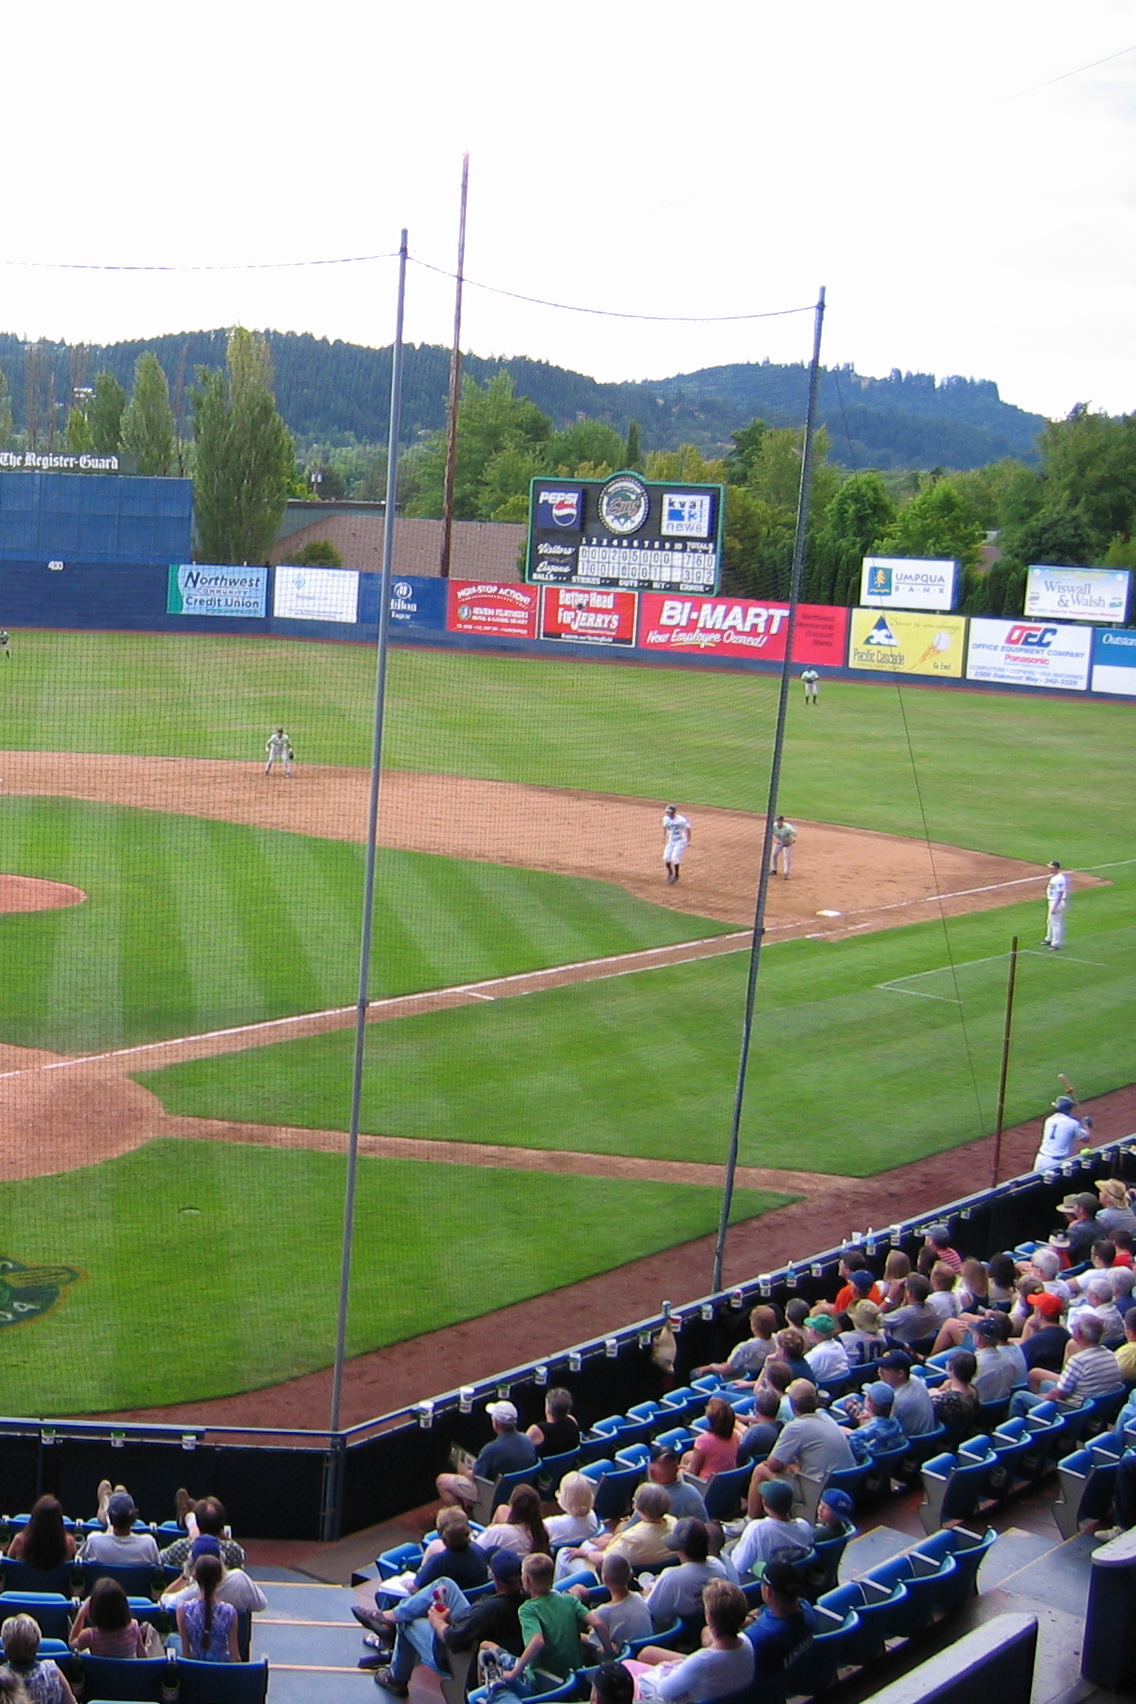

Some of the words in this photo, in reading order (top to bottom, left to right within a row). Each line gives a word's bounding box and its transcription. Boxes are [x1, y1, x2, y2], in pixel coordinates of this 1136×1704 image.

[0, 452, 22, 468] The
[24, 452, 118, 470] Register-Guard
[539, 491, 579, 504] PEPSI
[47, 560, 64, 571] 400
[184, 570, 261, 588] Northwest
[895, 573, 946, 584] UMPQUA
[198, 588, 249, 596] COMMUNITY
[1044, 581, 1092, 595] Wiswall
[186, 596, 222, 607] Credit
[225, 597, 259, 608] Union
[559, 589, 589, 608] Better
[1057, 594, 1069, 608] &
[1070, 593, 1106, 608] Walsh
[557, 607, 575, 625] For
[570, 609, 619, 630] JERRY'S
[659, 600, 791, 635] BI-MART
[670, 628, 721, 649] Employee
[722, 629, 769, 649] Owned!
[854, 648, 876, 662] Pacific
[876, 650, 905, 665] Cascade
[972, 642, 999, 652] OFFICE
[1000, 645, 1045, 655] EQUIPMENT
[1046, 649, 1086, 659] COMPANY
[1005, 654, 1050, 665] Panasonic
